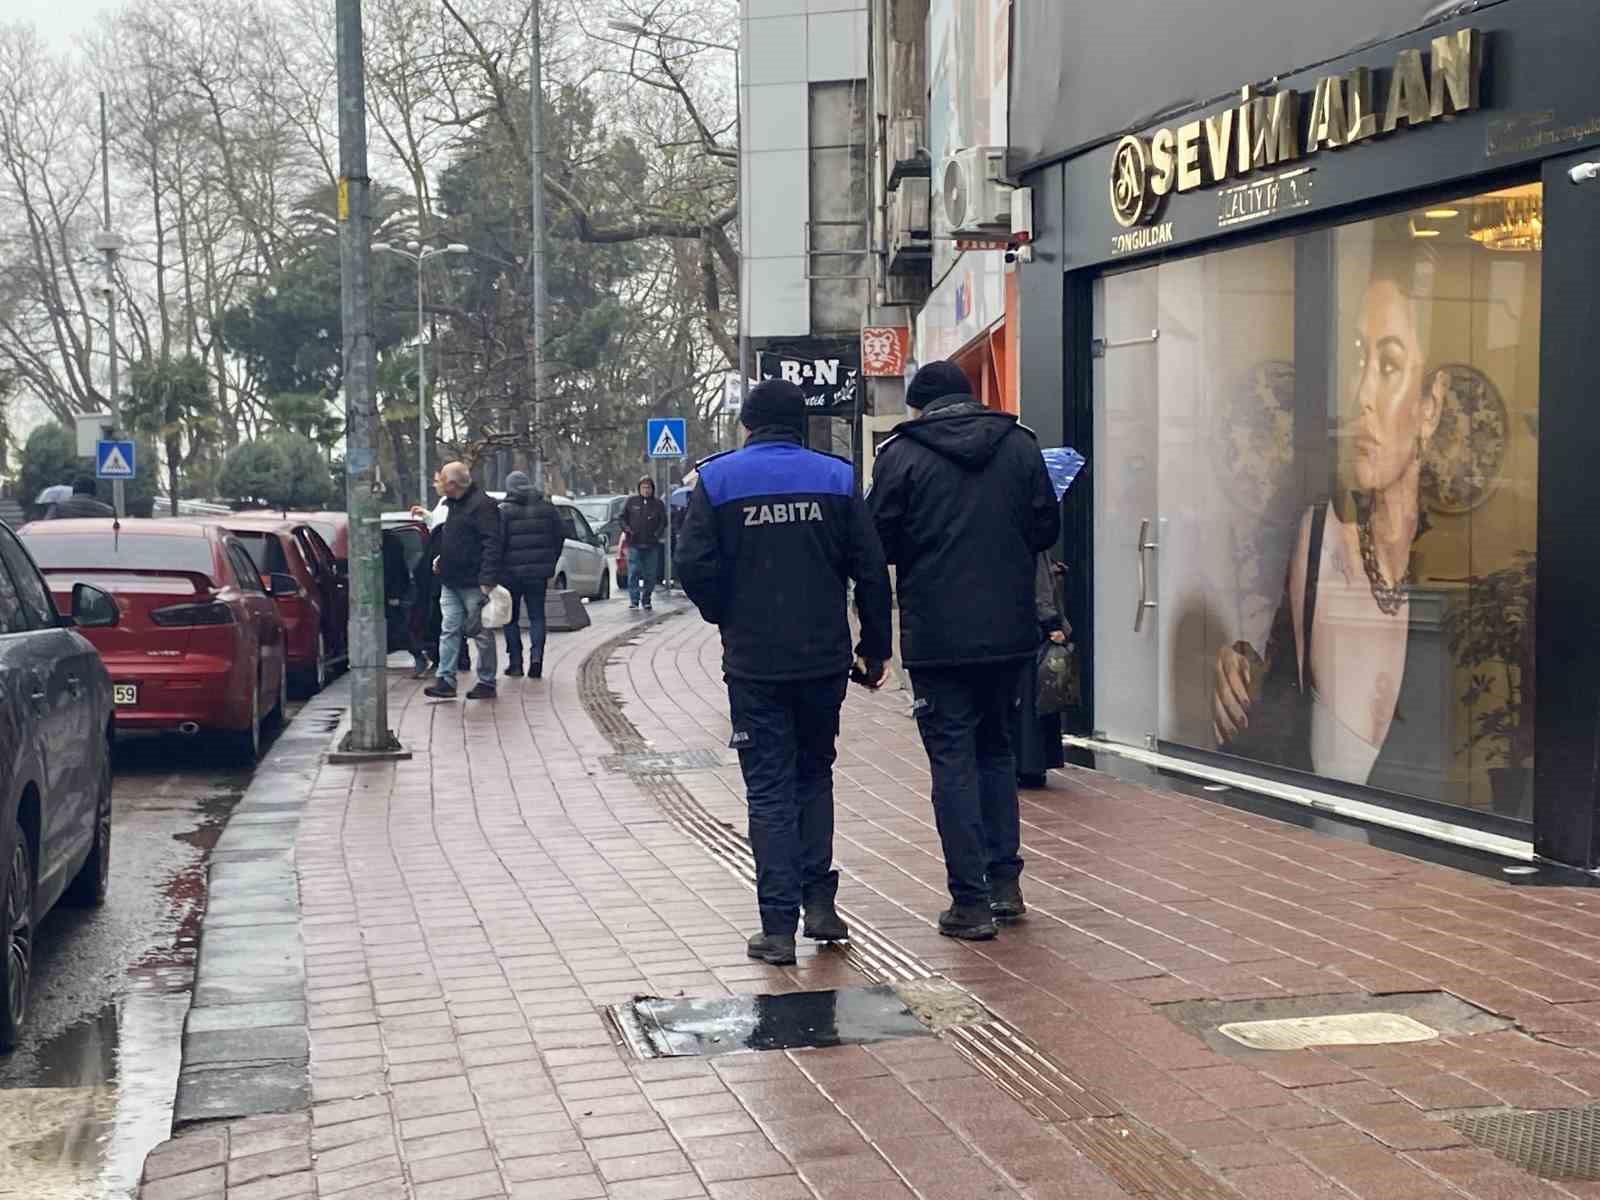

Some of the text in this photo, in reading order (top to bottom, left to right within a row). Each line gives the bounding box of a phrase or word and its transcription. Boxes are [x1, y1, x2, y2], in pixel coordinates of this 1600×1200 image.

[1151, 28, 1480, 196] SEVİM ALAN
[780, 359, 840, 386] R&N
[803, 393, 825, 406] utik
[743, 502, 824, 526] ZABITA
